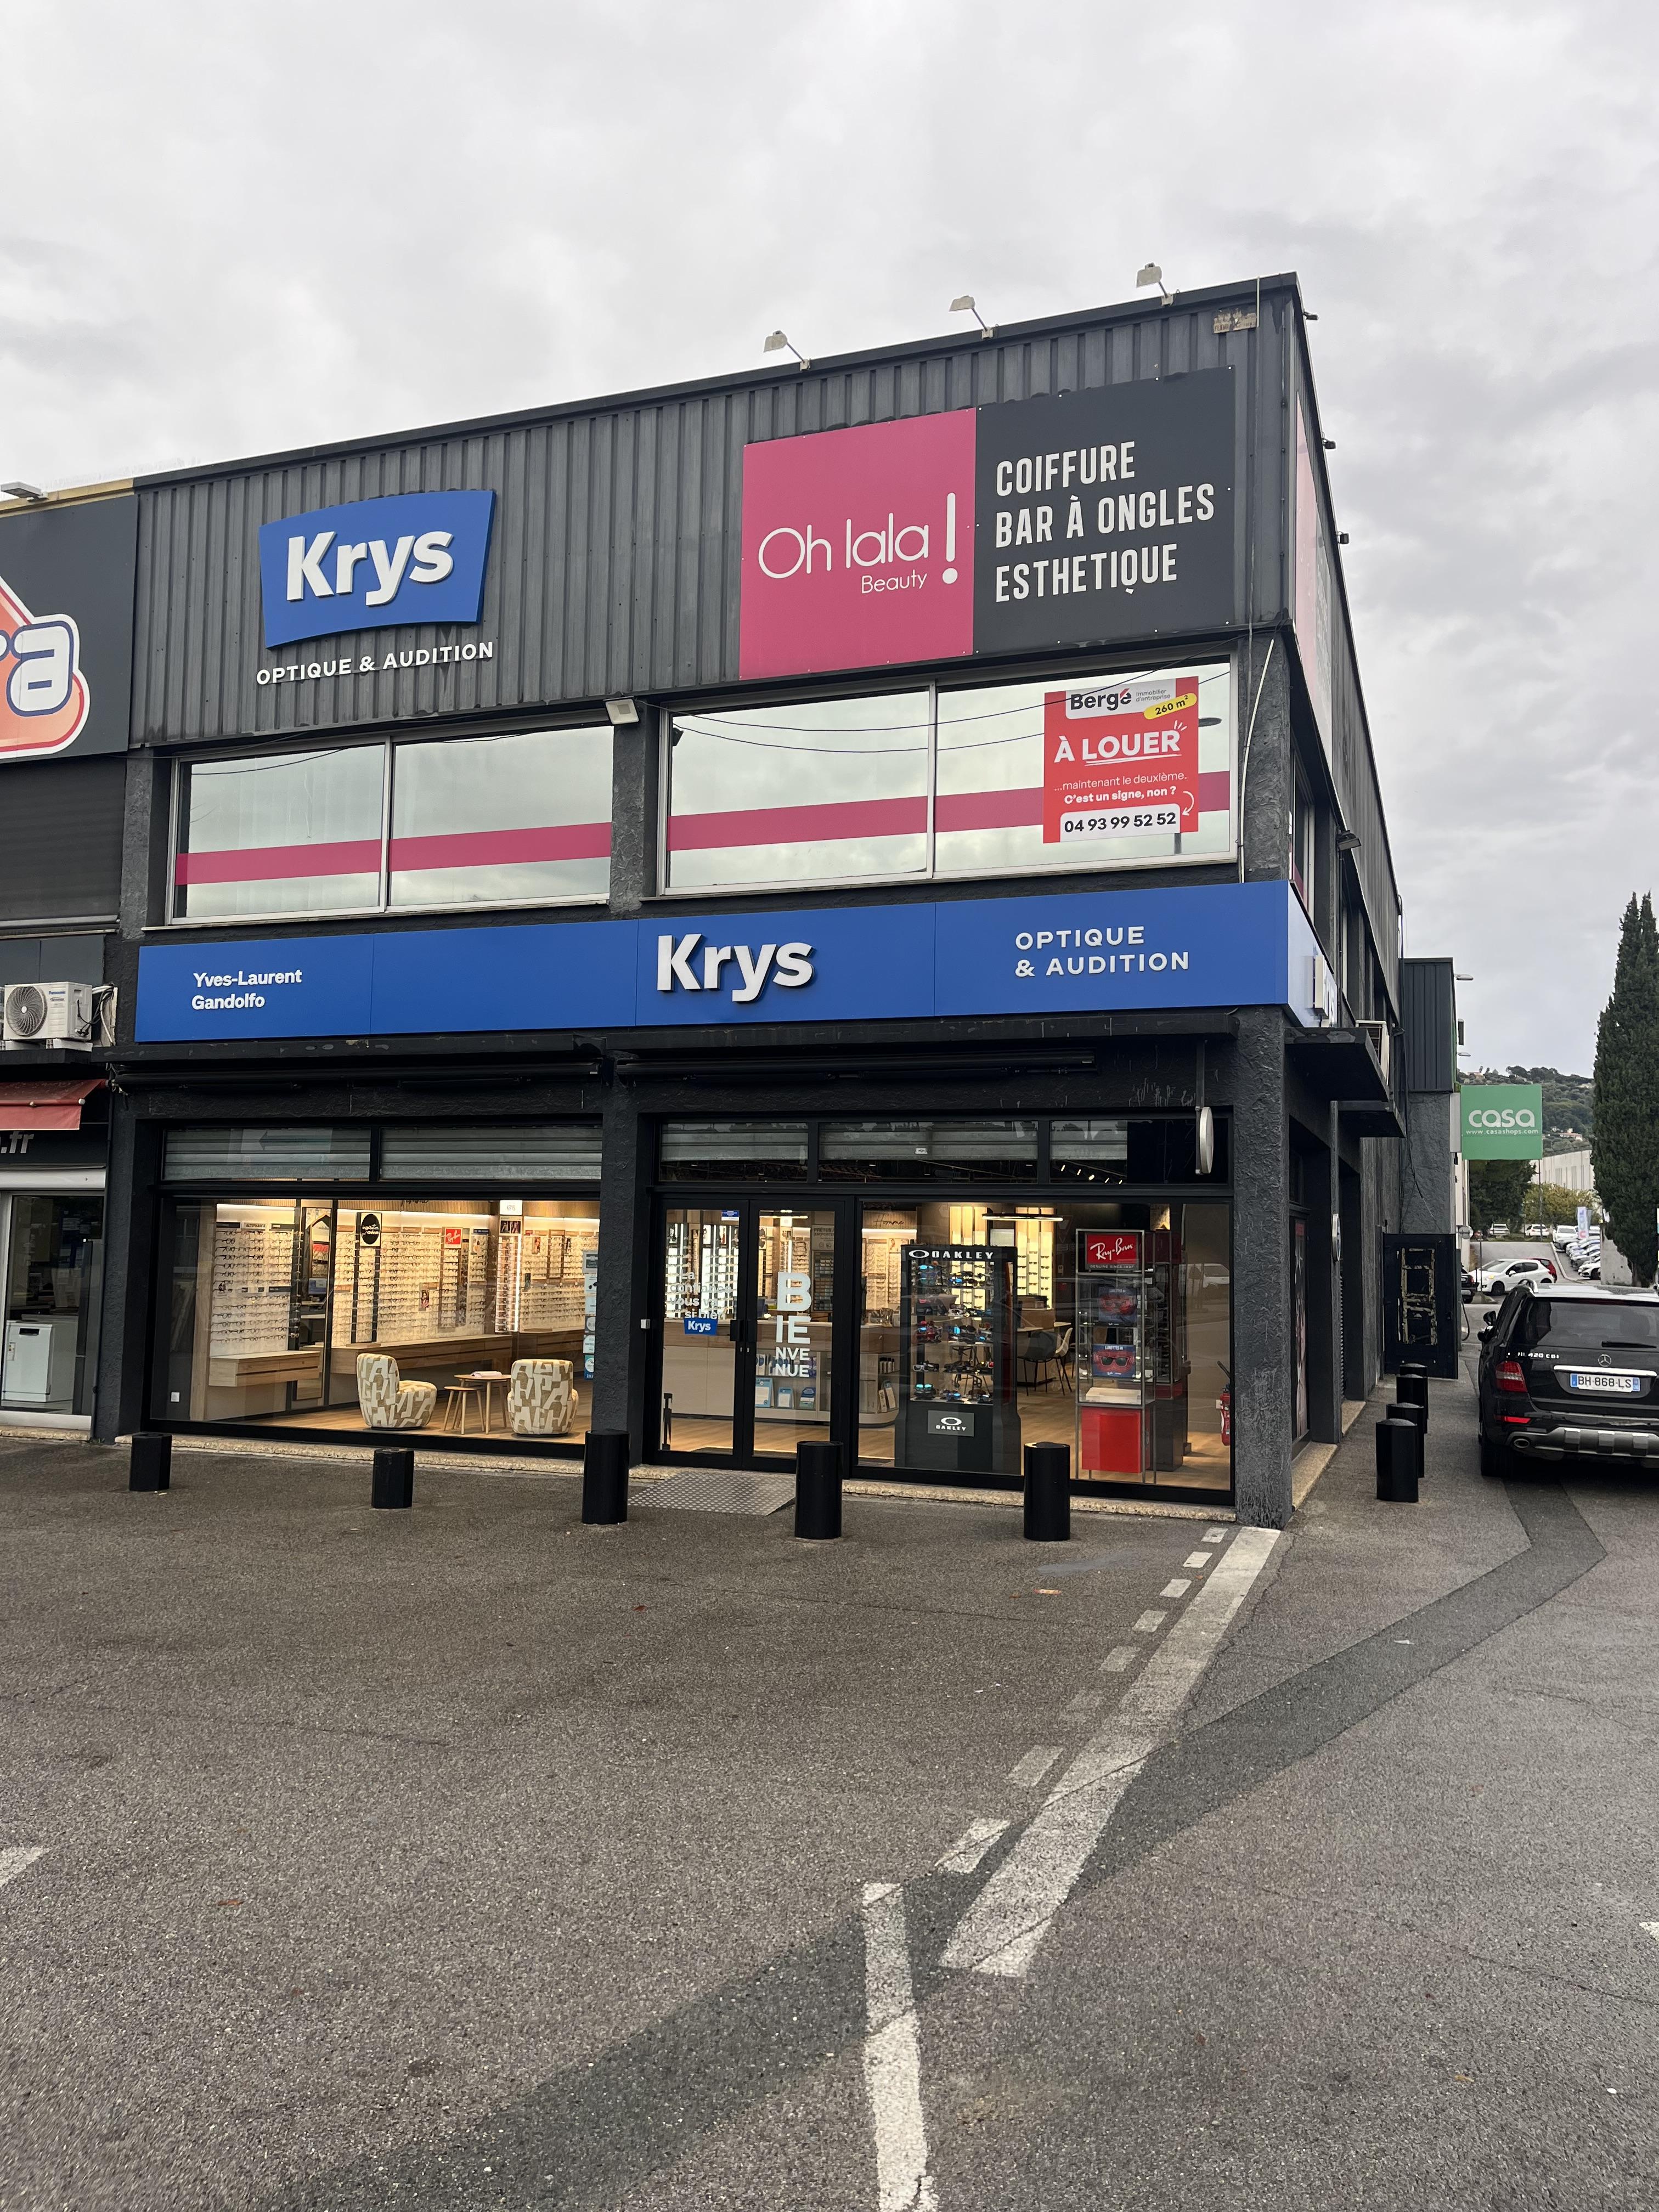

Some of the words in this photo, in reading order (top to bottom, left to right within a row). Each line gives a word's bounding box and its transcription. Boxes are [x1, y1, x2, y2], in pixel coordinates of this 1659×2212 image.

[996, 441, 1136, 497] COIFFURE
[996, 506, 1053, 548] BAR
[1066, 495, 1085, 539] À
[1098, 483, 1215, 534] ONGLES
[758, 524, 832, 579] Oh
[845, 512, 929, 569] lala
[942, 493, 959, 585] !
[286, 531, 454, 606] Krys
[996, 544, 1177, 602] ESTHETIQUE
[861, 569, 928, 594] Beauty
[256, 658, 351, 685] OPTIQUE
[359, 656, 375, 672] &
[383, 641, 493, 669] AUDITION
[1071, 689, 1132, 710] Bergé
[1155, 703, 1173, 715] 260
[1054, 736, 1075, 763] À
[1082, 730, 1181, 760] LOUER
[1122, 775, 1131, 785] le
[1134, 771, 1187, 784] deuxième.
[1064, 794, 1093, 804] C'est
[1111, 791, 1144, 802] signe,
[1147, 789, 1167, 797] non
[1170, 786, 1177, 794] ?
[1064, 820, 1084, 833] 04
[1088, 819, 1107, 831] 93
[1110, 816, 1130, 829] 99
[1133, 814, 1153, 827] 52
[1156, 812, 1176, 825] 52
[1015, 925, 1144, 951] OPTIQUE
[657, 933, 815, 1003] Krys
[1015, 958, 1035, 978] &
[1046, 951, 1189, 977] AUDITION
[193, 969, 302, 988] Yves-Laurent
[191, 992, 266, 1010] Gandolfo
[1468, 1109, 1535, 1128] casa
[873, 1214, 904, 1227] Homme
[932, 1251, 994, 1259] OAKLEY
[1090, 1237, 1133, 1260] Ray-Ban
[680, 1272, 695, 1280] La
[670, 1297, 699, 1306] vous
[777, 1272, 812, 1311] B
[688, 1321, 711, 1333] Krys
[776, 1315, 811, 1344] IE
[776, 1347, 810, 1361] NVE
[775, 1364, 810, 1378] NUE
